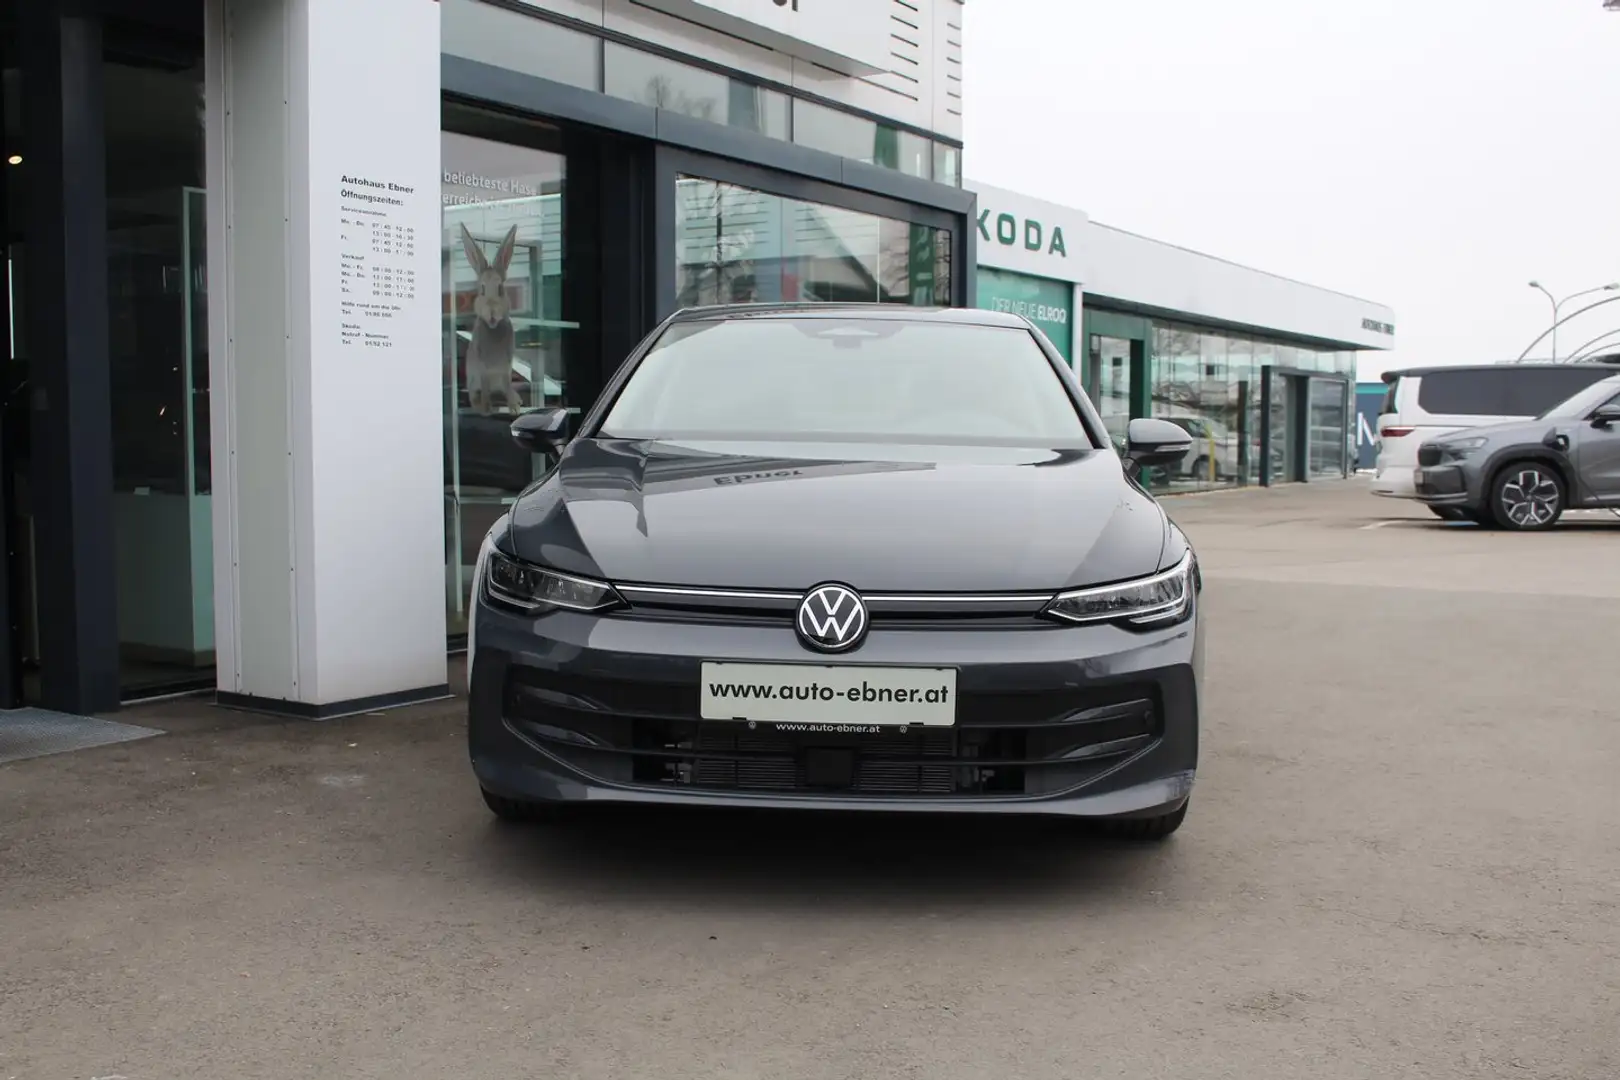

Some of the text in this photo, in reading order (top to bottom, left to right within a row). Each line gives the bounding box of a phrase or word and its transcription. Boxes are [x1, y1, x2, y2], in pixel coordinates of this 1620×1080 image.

[341, 175, 414, 194] Autohaus Ebner
[444, 167, 509, 191] beliebteste
[340, 188, 404, 206] Öffnungszeiten:
[709, 681, 948, 703] www.auto-ebner.at
[776, 722, 880, 734] www.auto-ebner.at
